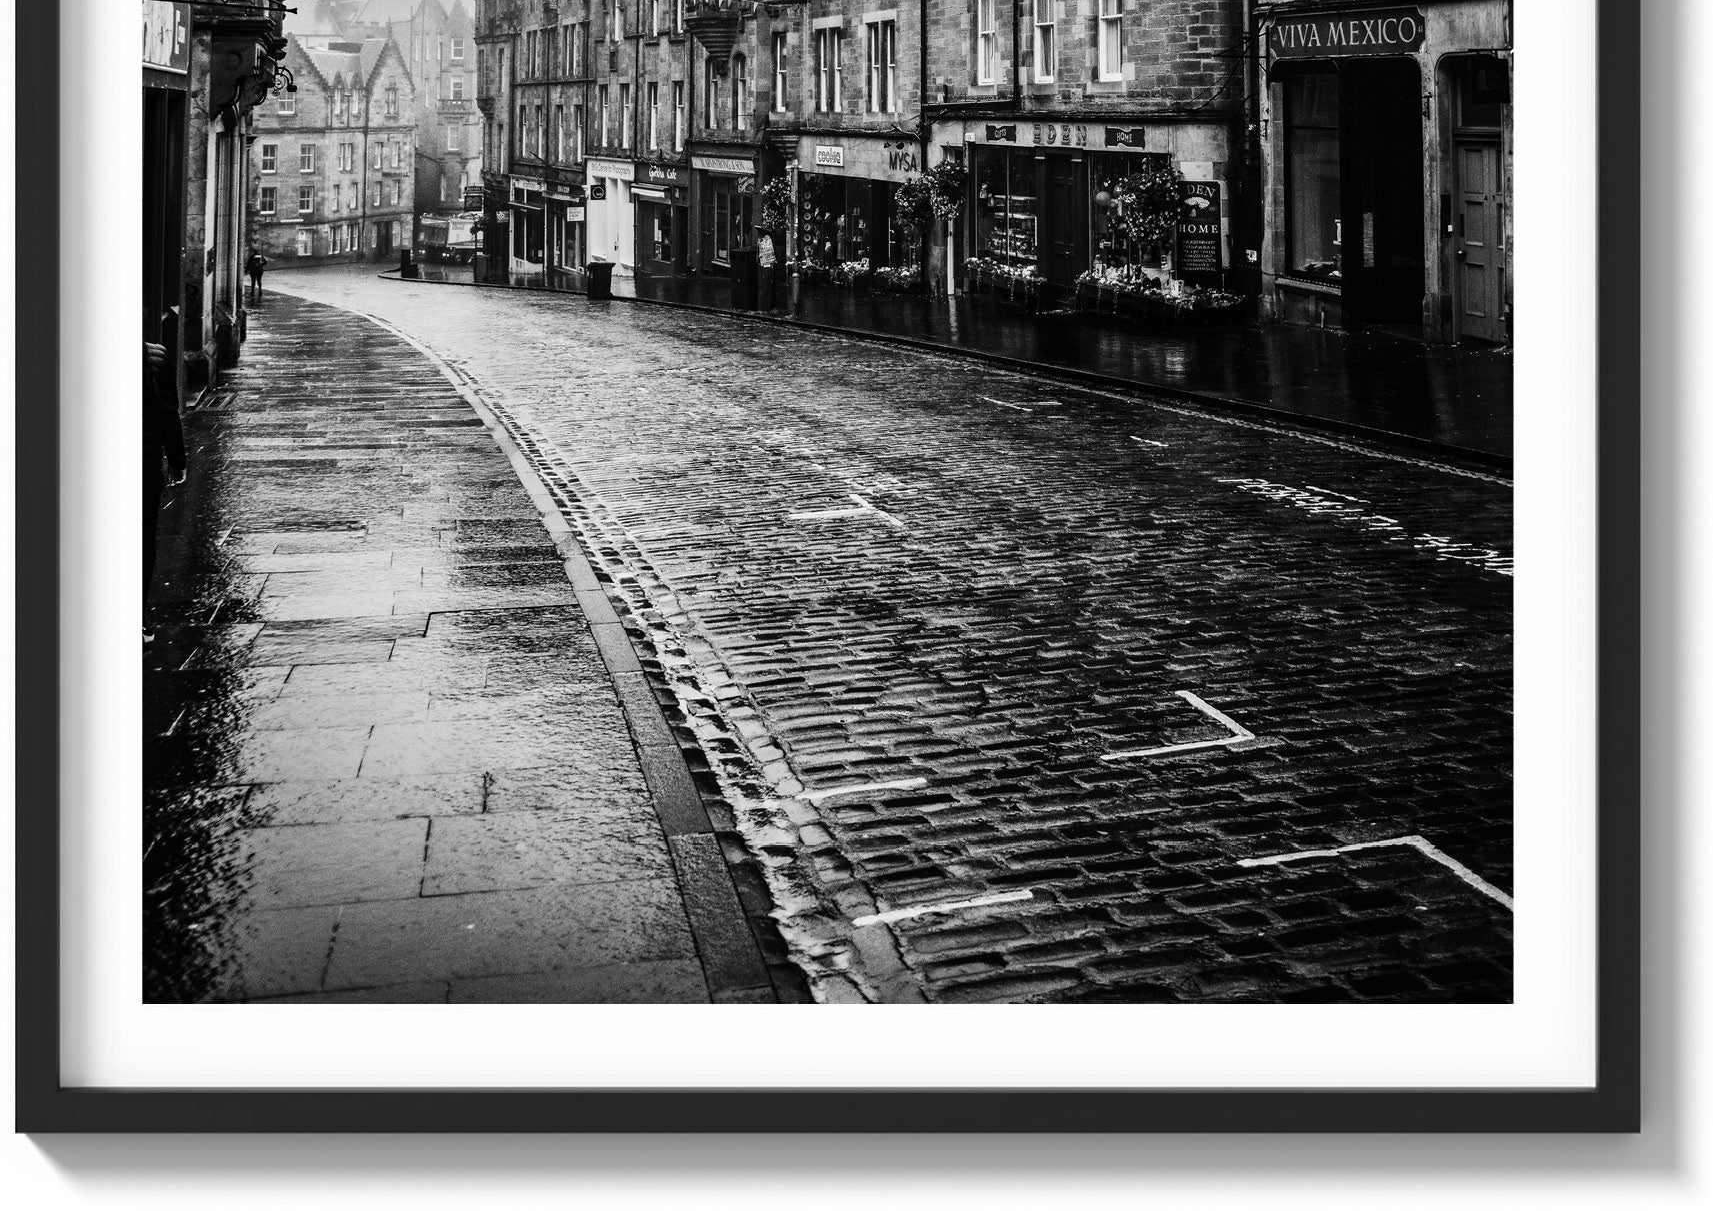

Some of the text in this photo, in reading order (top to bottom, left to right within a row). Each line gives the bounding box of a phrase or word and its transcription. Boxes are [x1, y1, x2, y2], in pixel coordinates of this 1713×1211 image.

[1277, 17, 1416, 48] VIVA MEXICO
[1033, 124, 1087, 147] EDEN
[1116, 132, 1132, 143] HOME
[889, 151, 917, 172] MYSA
[1187, 184, 1216, 198] DEN
[1179, 224, 1218, 234] HOME
